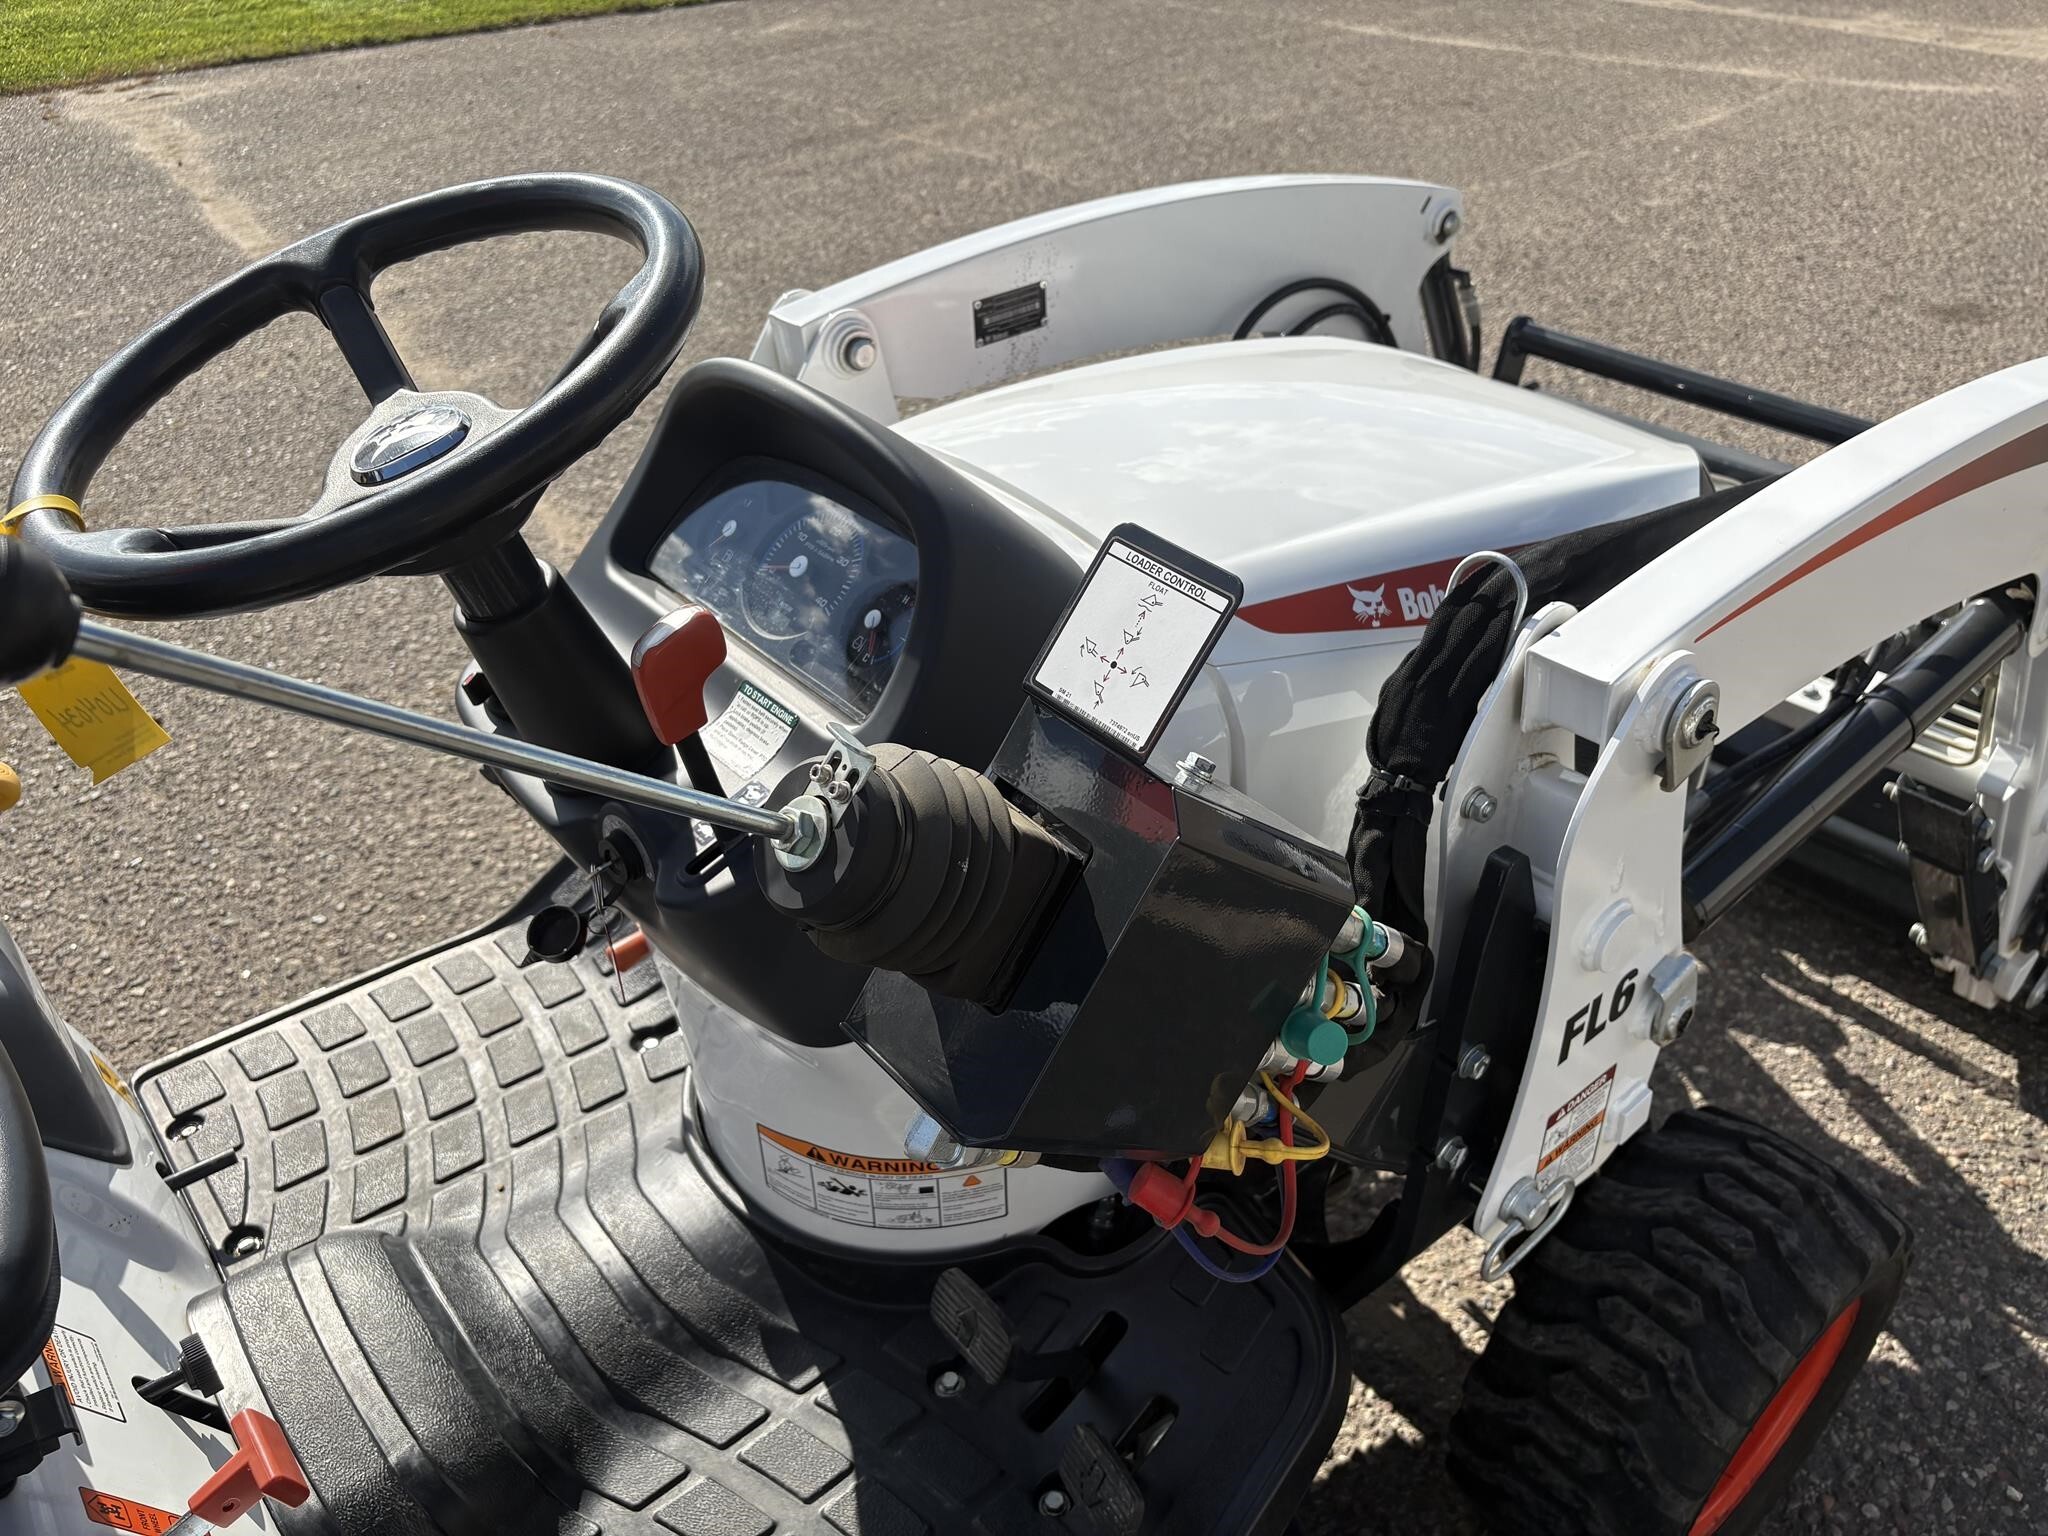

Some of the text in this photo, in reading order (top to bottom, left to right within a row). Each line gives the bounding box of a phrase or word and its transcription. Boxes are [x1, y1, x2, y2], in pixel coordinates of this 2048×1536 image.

[836, 556, 849, 567] 30
[1125, 551, 1207, 602] LOADER CONTROL
[816, 597, 828, 608] 40
[1148, 581, 1169, 596] FLOAT
[1396, 583, 1446, 622] Bob
[744, 684, 794, 726] TO START ENGINE
[1557, 968, 1640, 1067] FL6
[1565, 1073, 1608, 1113] DANGER
